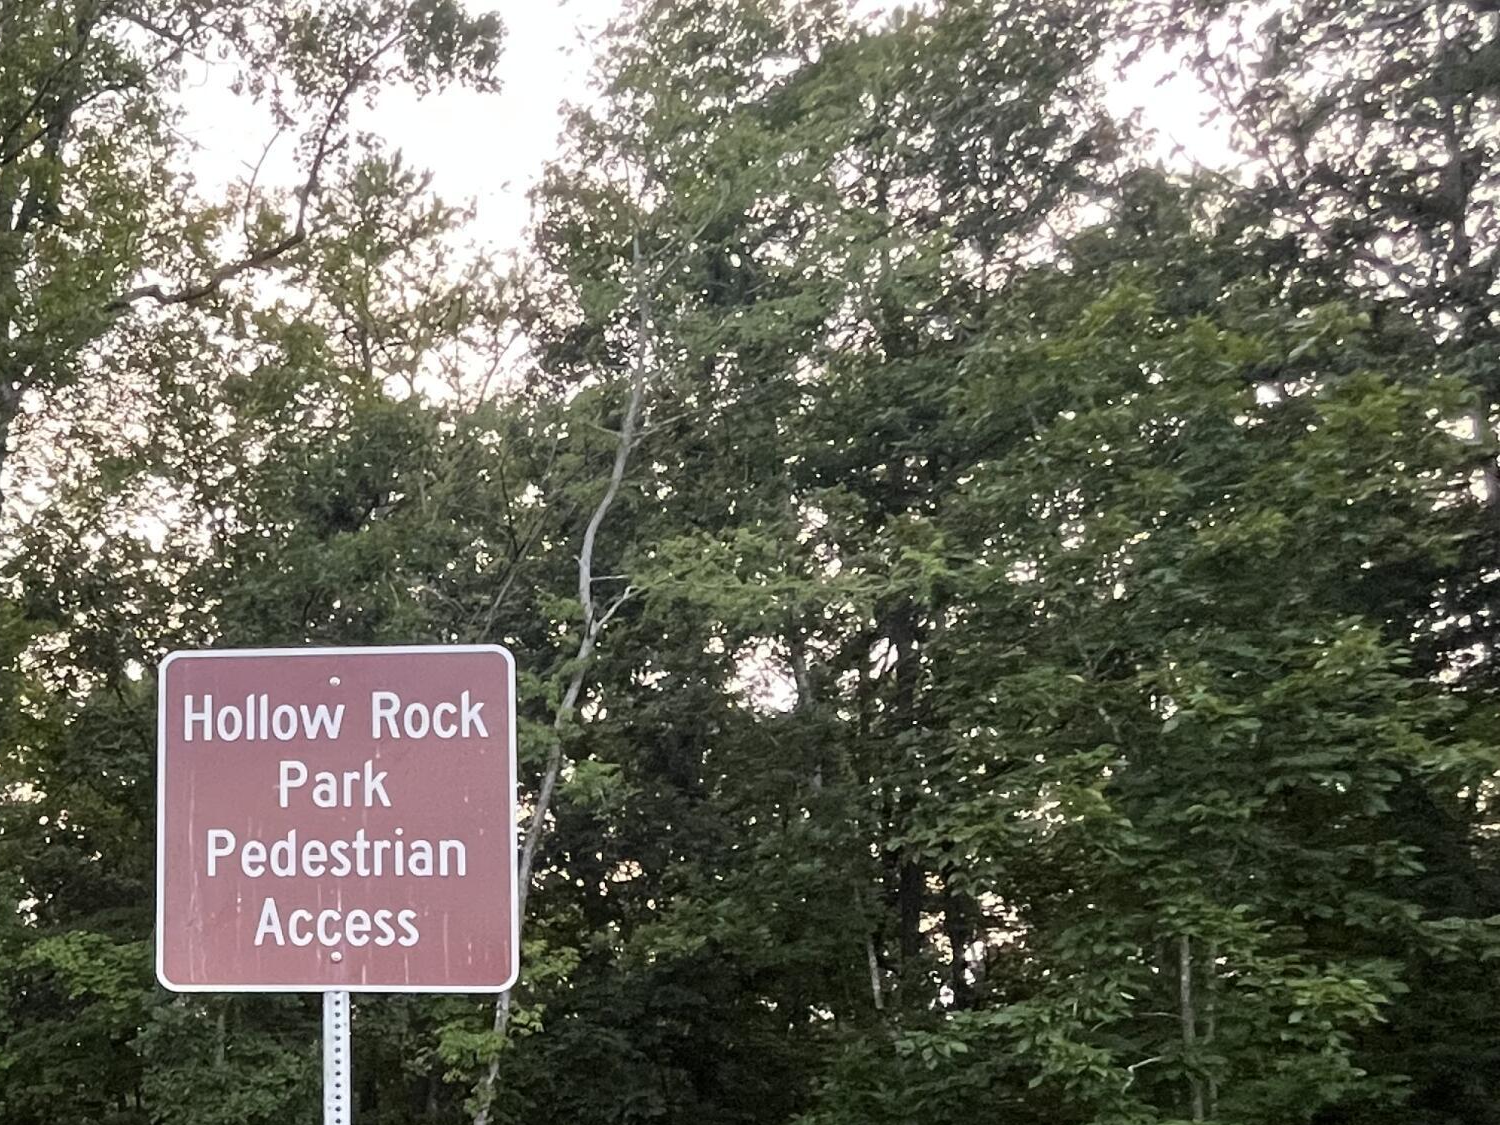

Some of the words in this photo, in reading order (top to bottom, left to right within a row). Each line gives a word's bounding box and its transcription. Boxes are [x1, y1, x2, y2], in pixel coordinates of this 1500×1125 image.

[183, 694, 346, 741] Hollow
[371, 690, 489, 739] Rock
[278, 759, 392, 808] Park
[206, 827, 467, 877] Pedestrian
[253, 897, 420, 947] Access
